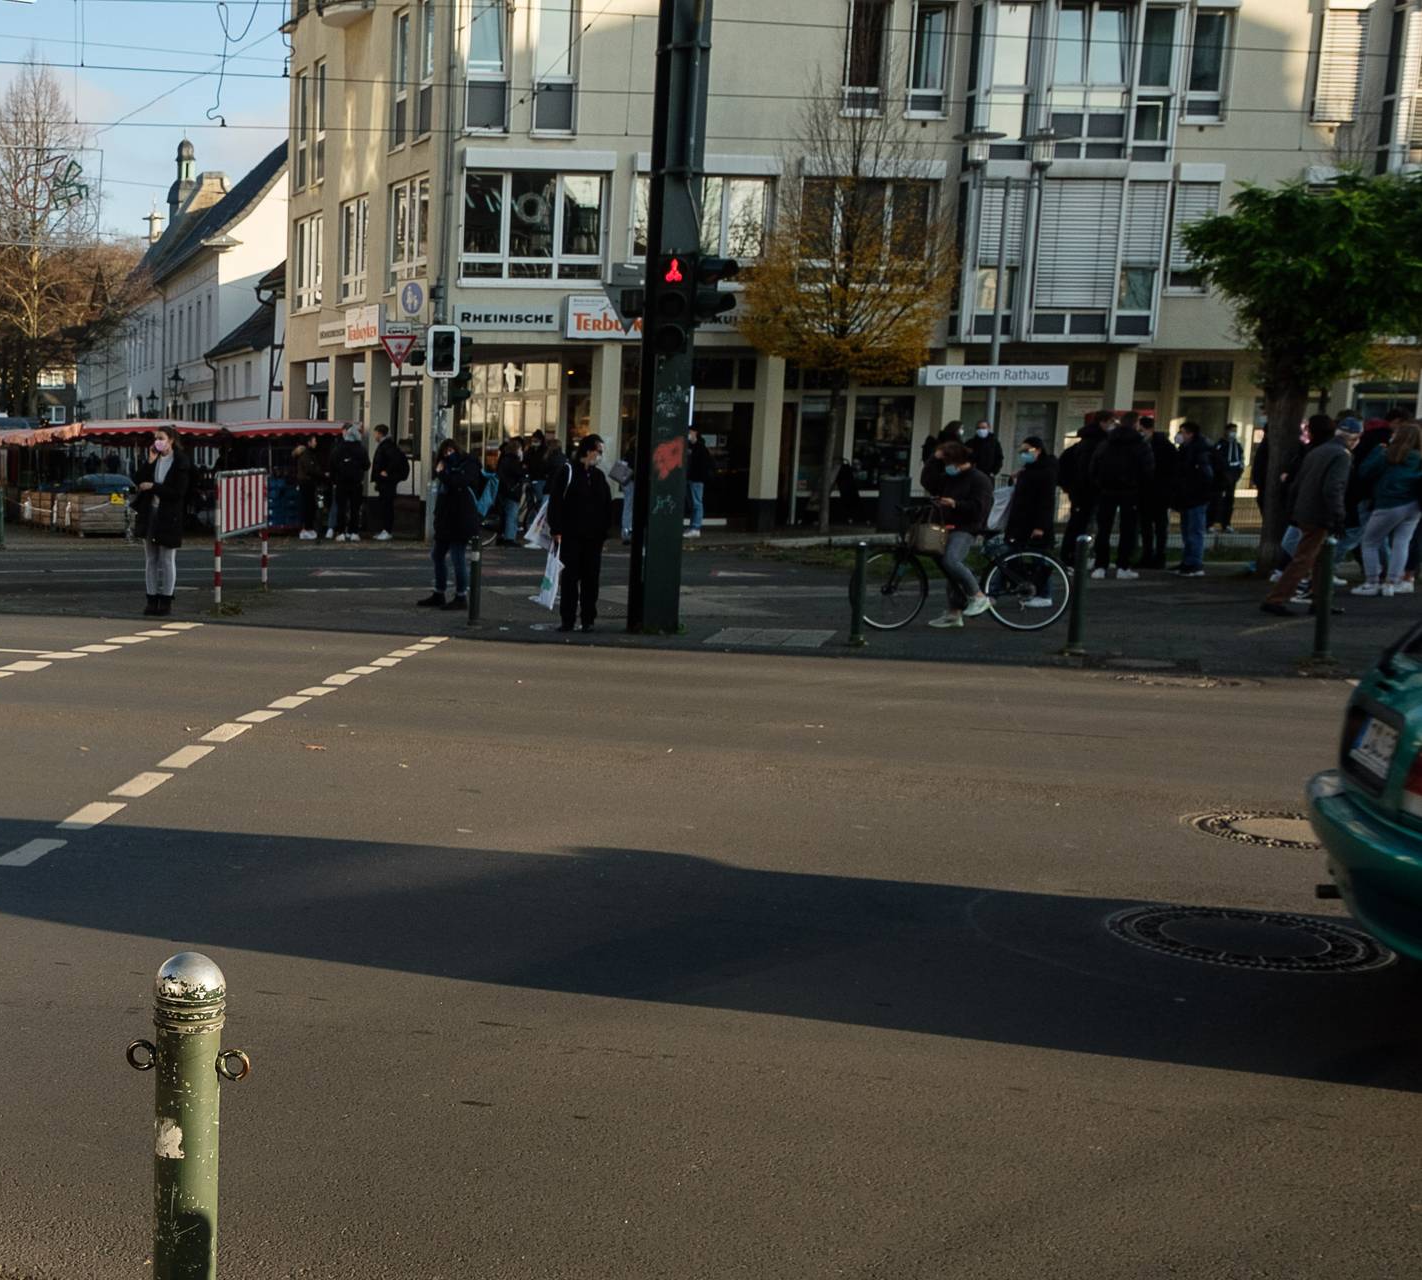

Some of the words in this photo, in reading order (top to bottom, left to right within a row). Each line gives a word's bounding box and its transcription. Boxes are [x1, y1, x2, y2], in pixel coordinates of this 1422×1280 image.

[460, 311, 554, 324] RHEINISCHE
[935, 368, 1000, 381] Gerresheim
[1004, 368, 1050, 381] Rathaus
